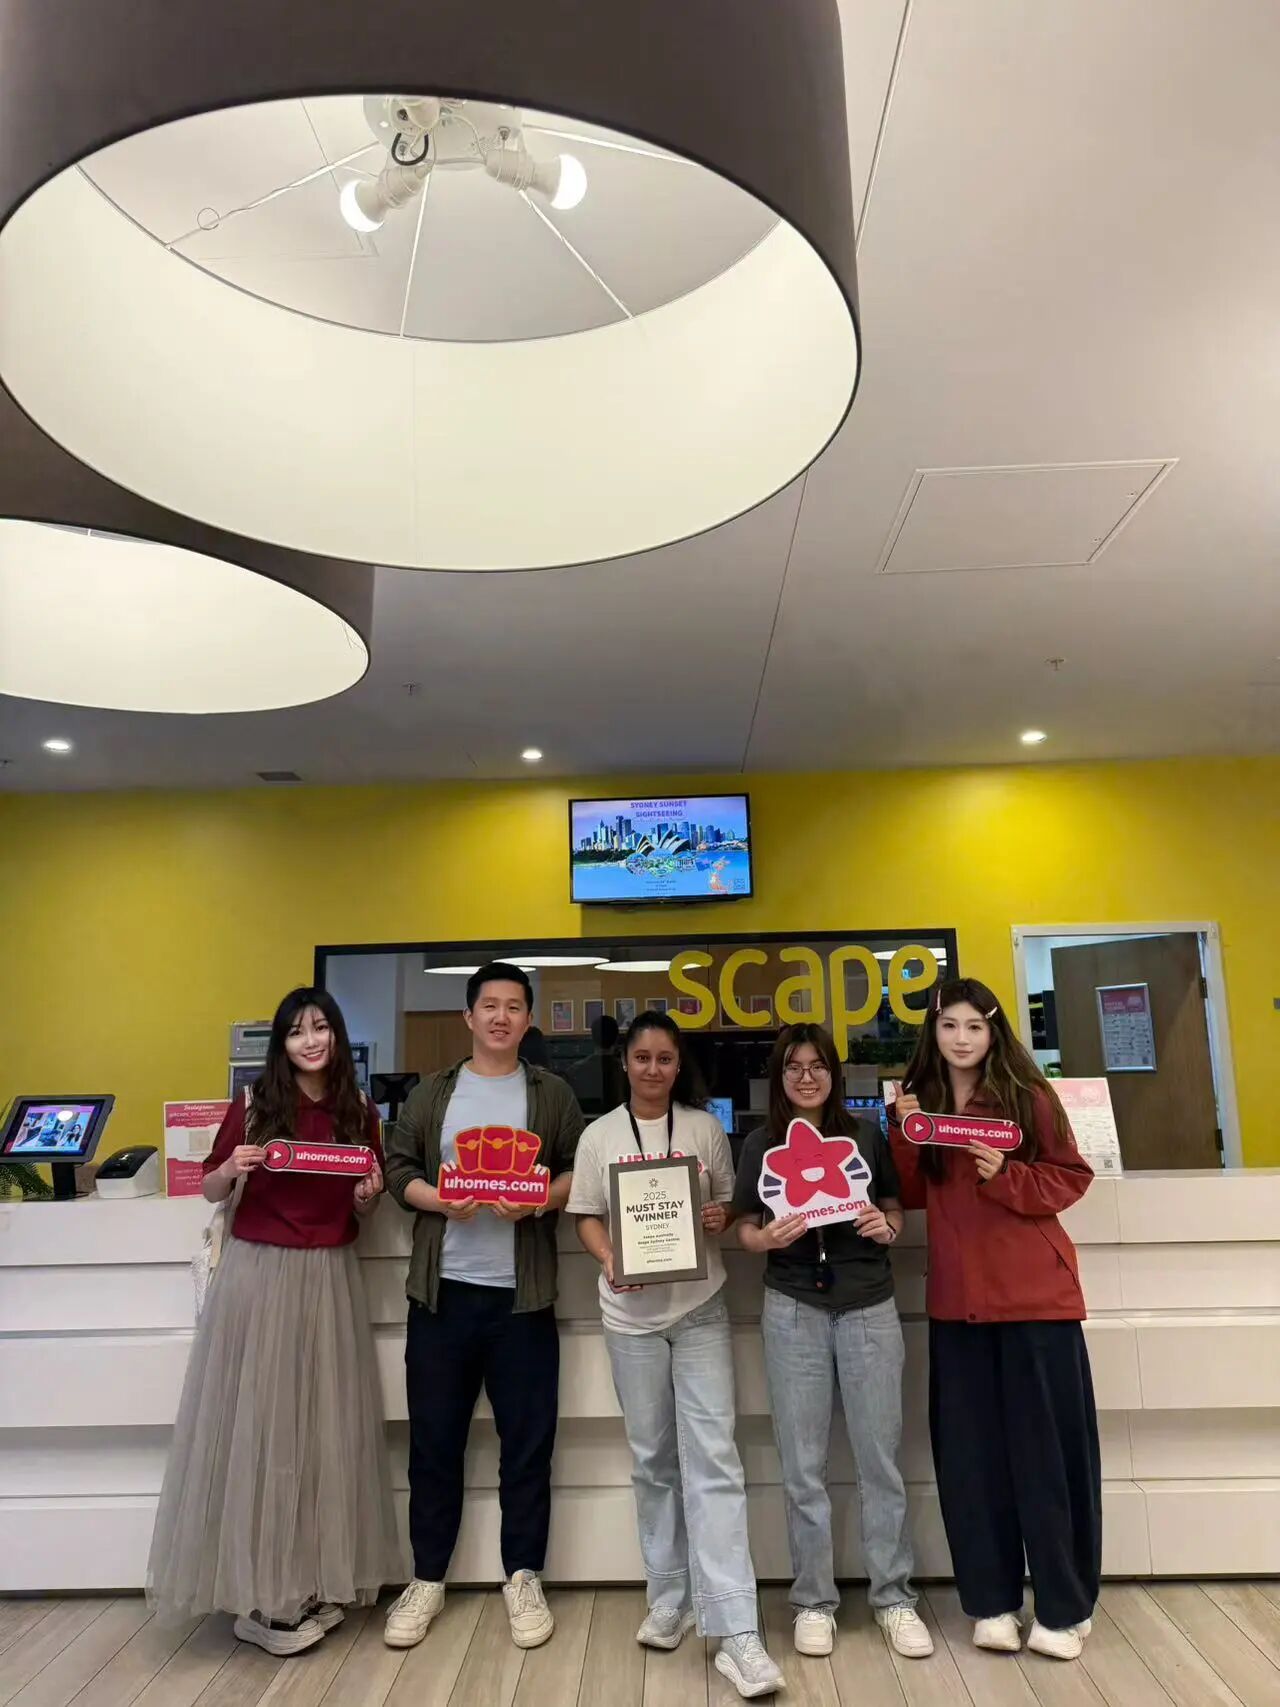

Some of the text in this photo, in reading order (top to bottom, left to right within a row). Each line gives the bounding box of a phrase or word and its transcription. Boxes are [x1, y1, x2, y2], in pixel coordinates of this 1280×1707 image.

[630, 800, 687, 809] SYDNEY SUNSET
[635, 810, 683, 818] SIGHTSEEING
[665, 943, 939, 1063] scape
[938, 1124, 1014, 1140] uhomes.com
[296, 1151, 368, 1165] uhomes.com
[444, 1175, 545, 1193] uhomes.com
[643, 1190, 667, 1202] 2025
[626, 1199, 685, 1214] MUST STAY
[780, 1198, 868, 1222] omes.com
[633, 1210, 679, 1223] WINNER
[645, 1222, 670, 1232] SYDNEY
